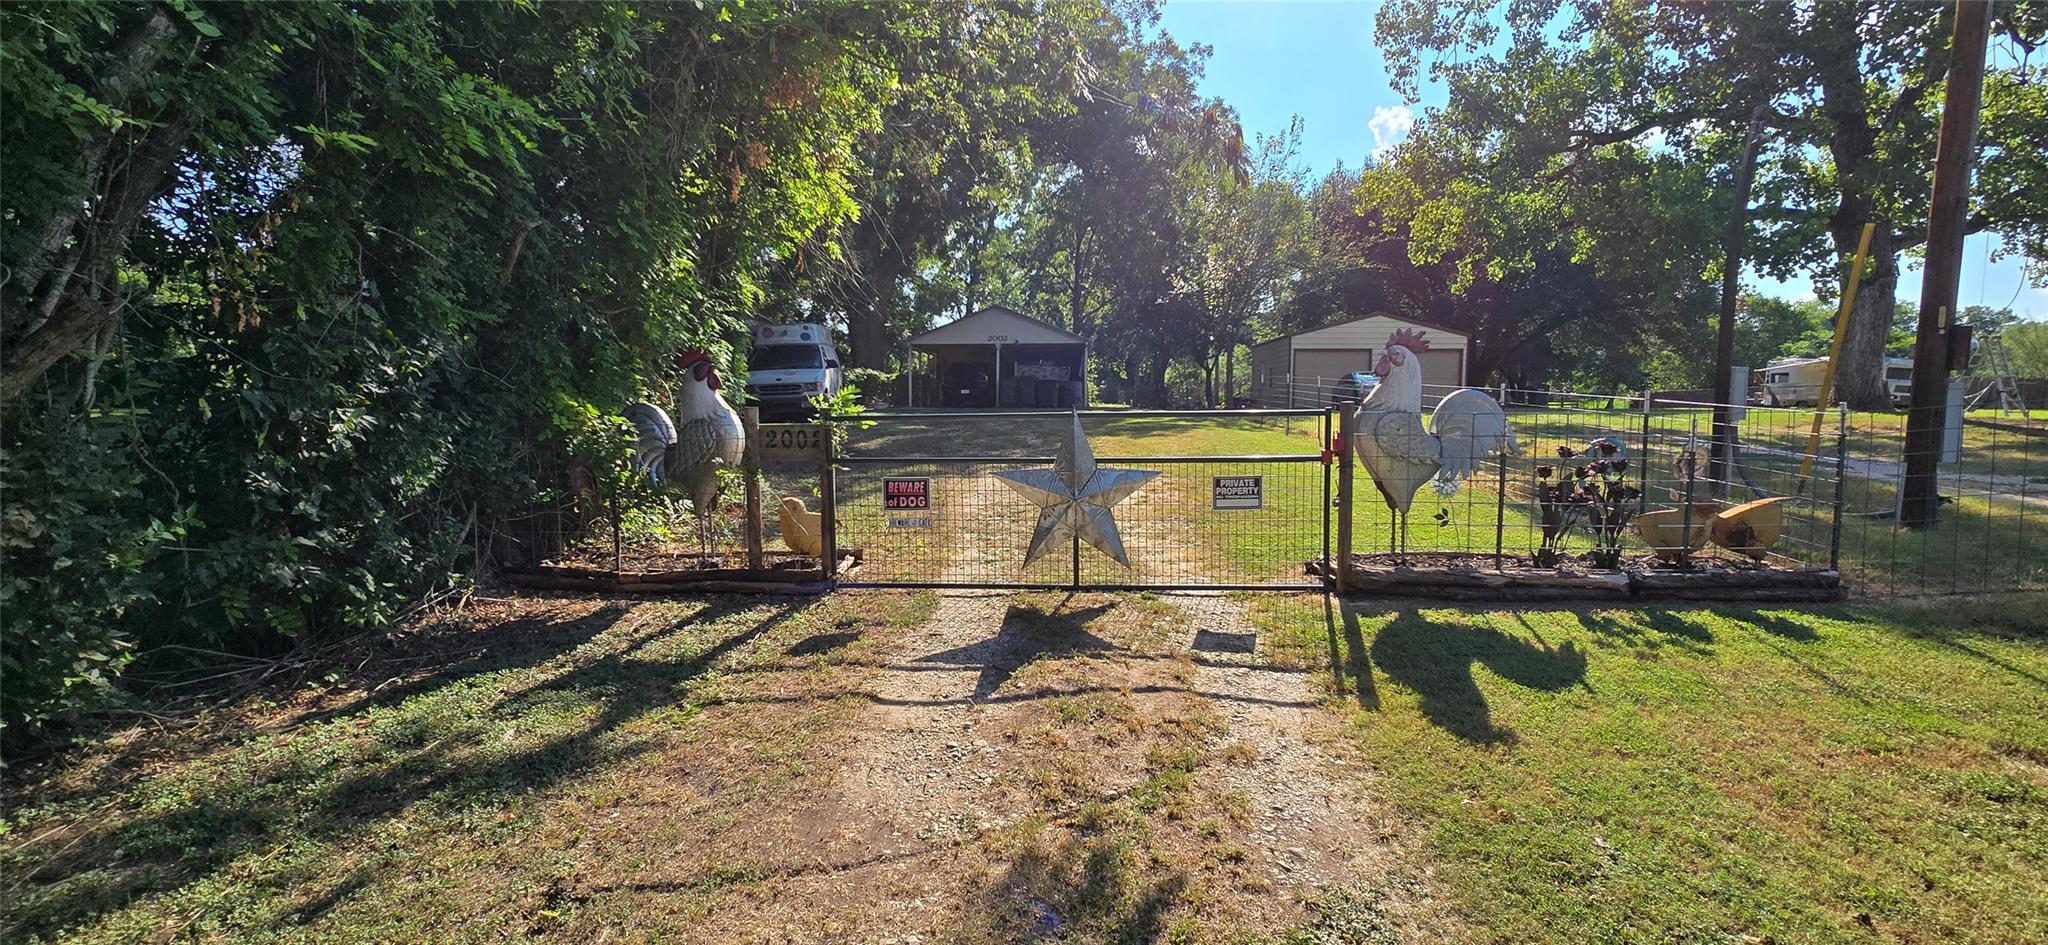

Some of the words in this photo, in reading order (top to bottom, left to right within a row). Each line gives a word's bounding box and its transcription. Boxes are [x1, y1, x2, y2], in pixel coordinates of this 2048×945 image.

[766, 429, 820, 449] 2002
[888, 481, 925, 493] BEWARE
[1220, 479, 1255, 487] PRIVATE
[1216, 487, 1259, 495] PROPERTY
[888, 498, 898, 507] of
[899, 496, 926, 507] DOG
